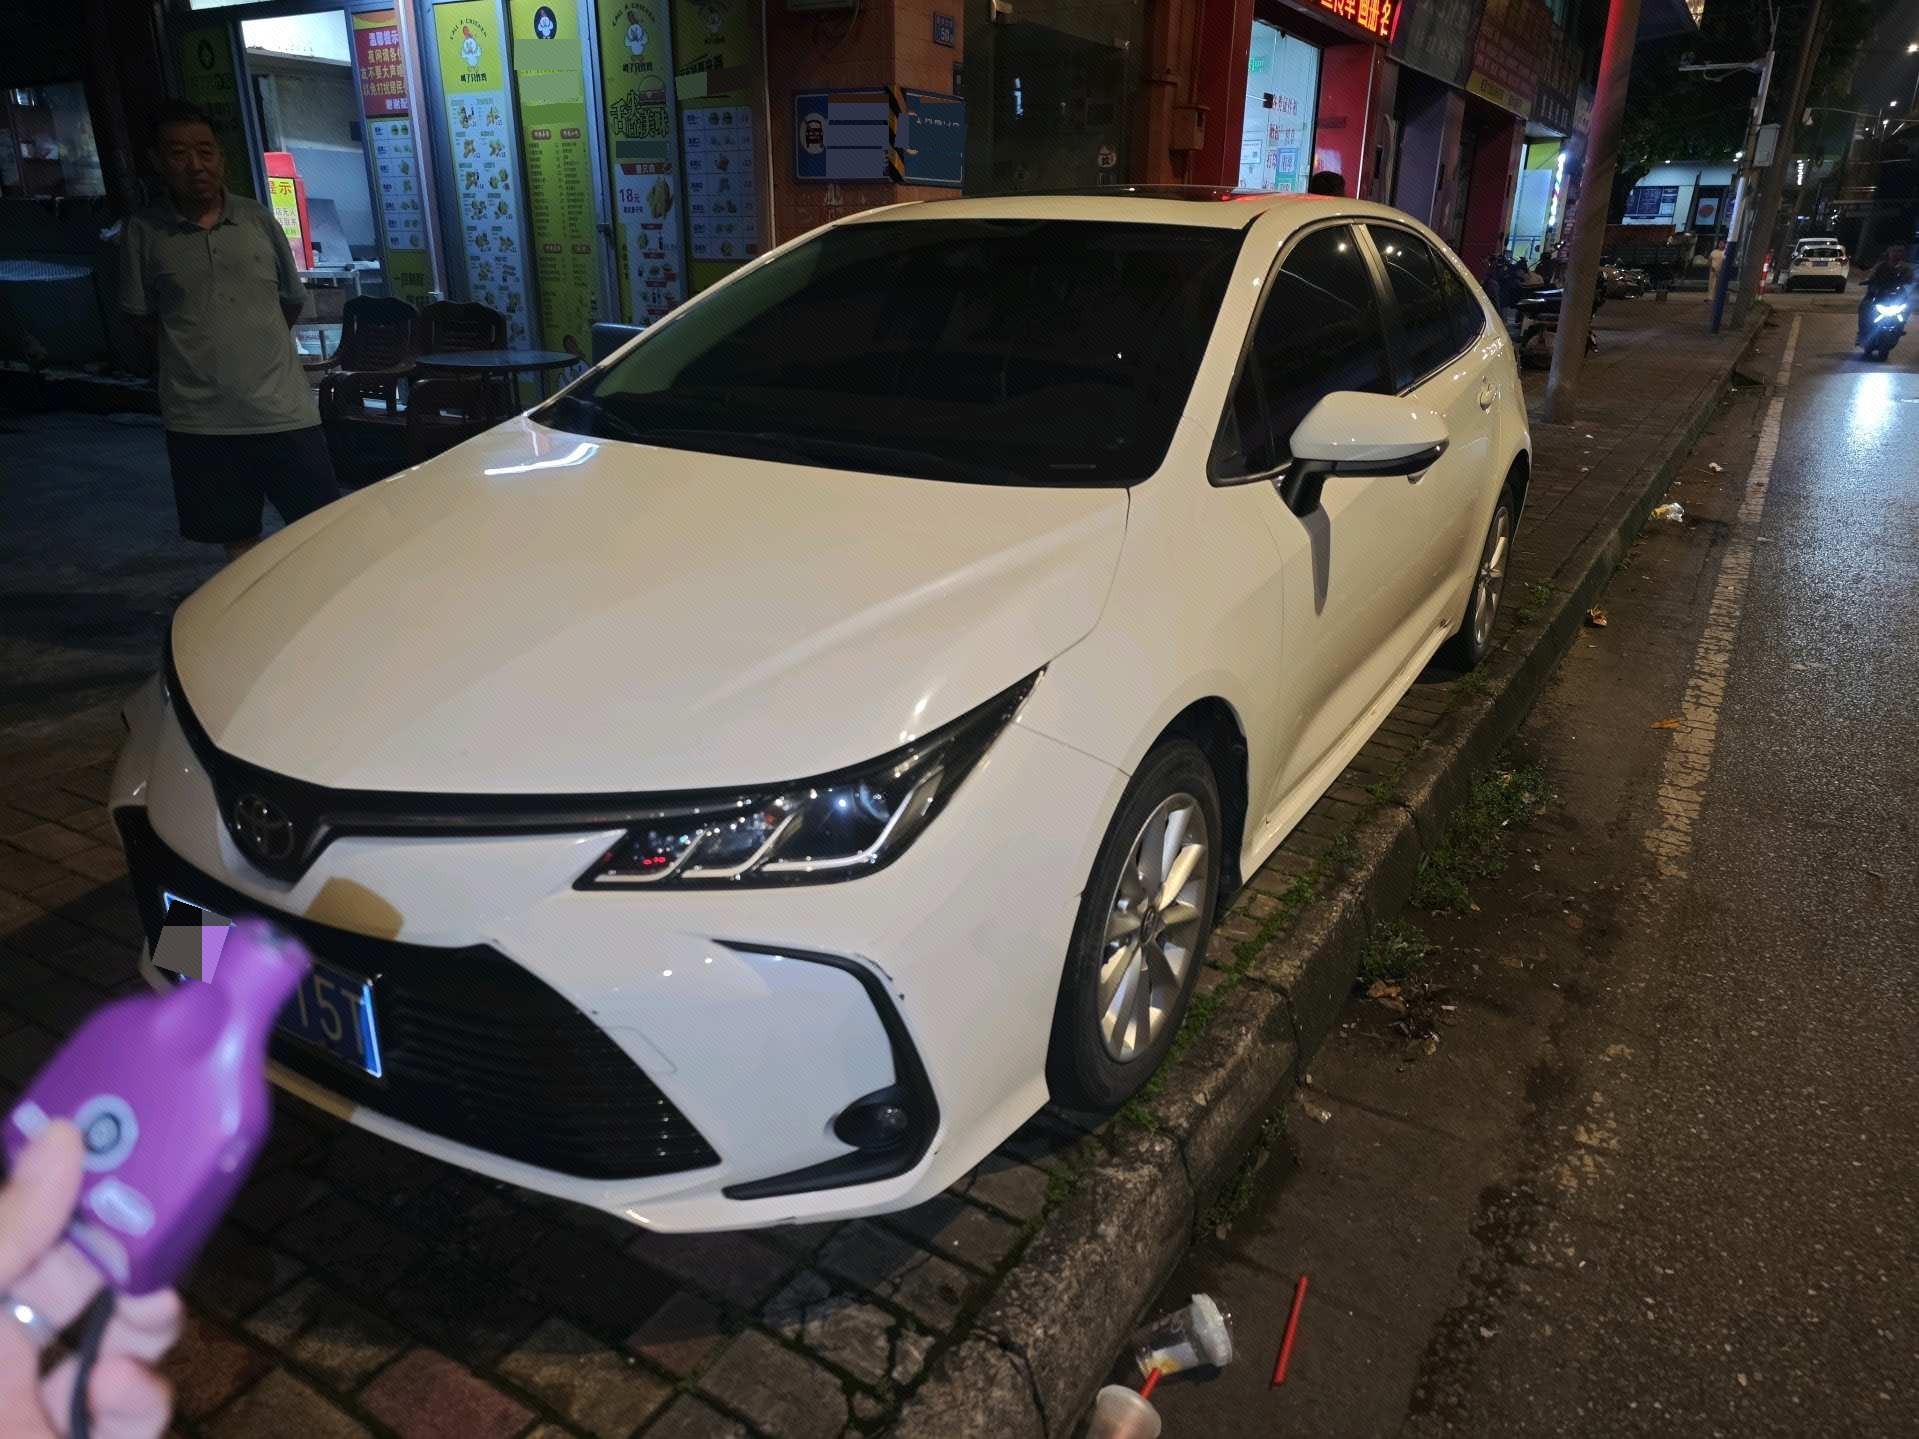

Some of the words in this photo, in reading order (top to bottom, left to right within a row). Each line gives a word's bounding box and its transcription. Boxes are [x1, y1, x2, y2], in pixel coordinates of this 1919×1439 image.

[368, 47, 401, 63] 夜间请各
[362, 80, 407, 96] 以免打扰居民
